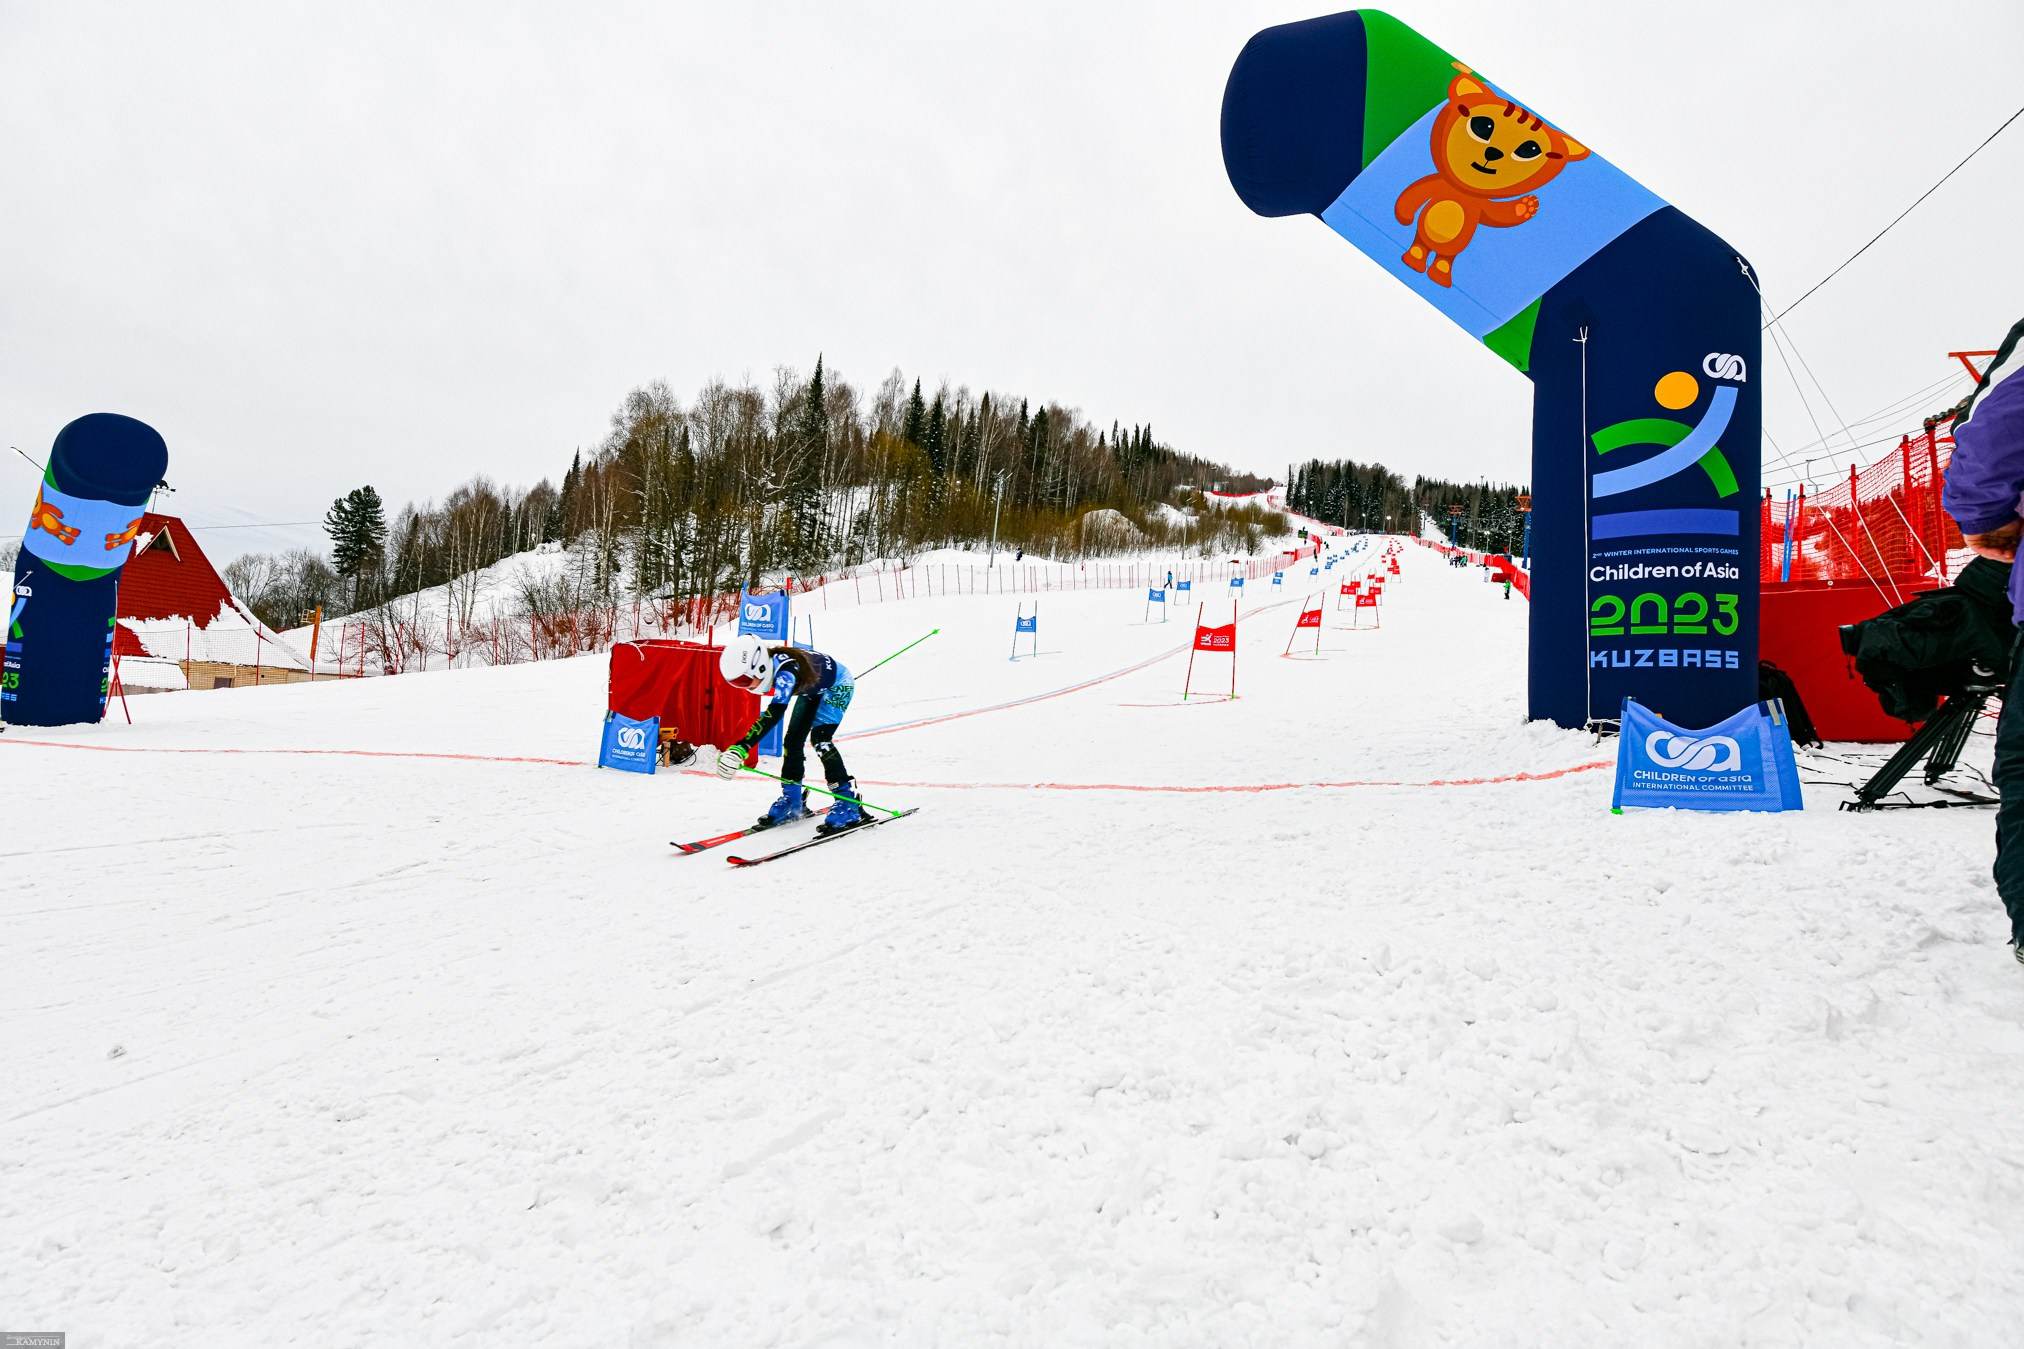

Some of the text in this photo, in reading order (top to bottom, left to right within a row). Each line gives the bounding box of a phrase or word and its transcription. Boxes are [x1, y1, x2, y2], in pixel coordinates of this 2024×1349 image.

[1604, 550, 1632, 558] WINTER
[1633, 547, 1694, 555] INTERNATIONAL
[1590, 562, 1739, 582] Children of Asia
[1590, 592, 1739, 637] 2023
[1590, 649, 1739, 669] KUZBASS
[1633, 770, 1695, 782] CHILDREN
[1632, 782, 1700, 791] INTERNATIONAL
